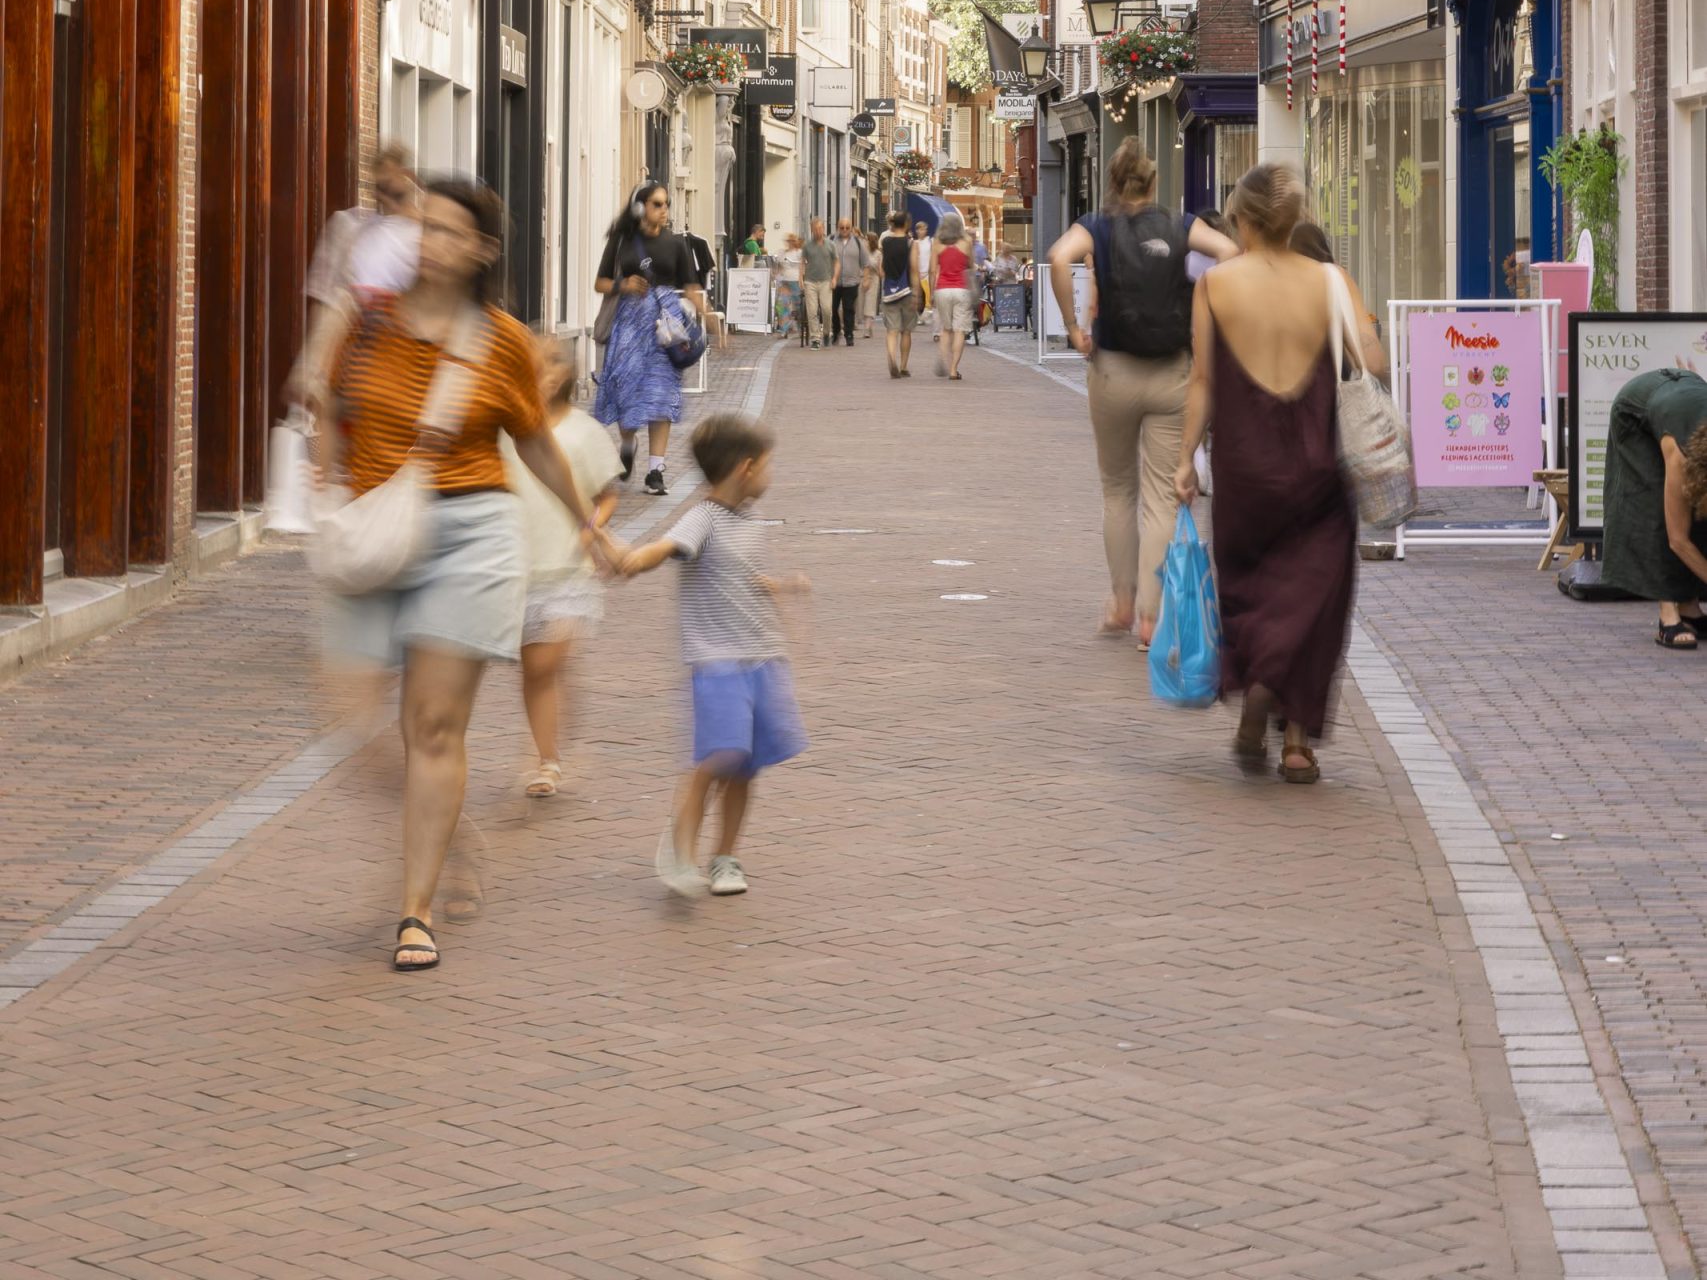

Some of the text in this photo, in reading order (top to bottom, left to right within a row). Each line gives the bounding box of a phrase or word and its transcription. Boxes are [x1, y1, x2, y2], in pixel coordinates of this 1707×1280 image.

[1445, 325, 1500, 350] Meesie
[1585, 332, 1650, 350] SEVEN
[1584, 353, 1642, 371] NAILS
